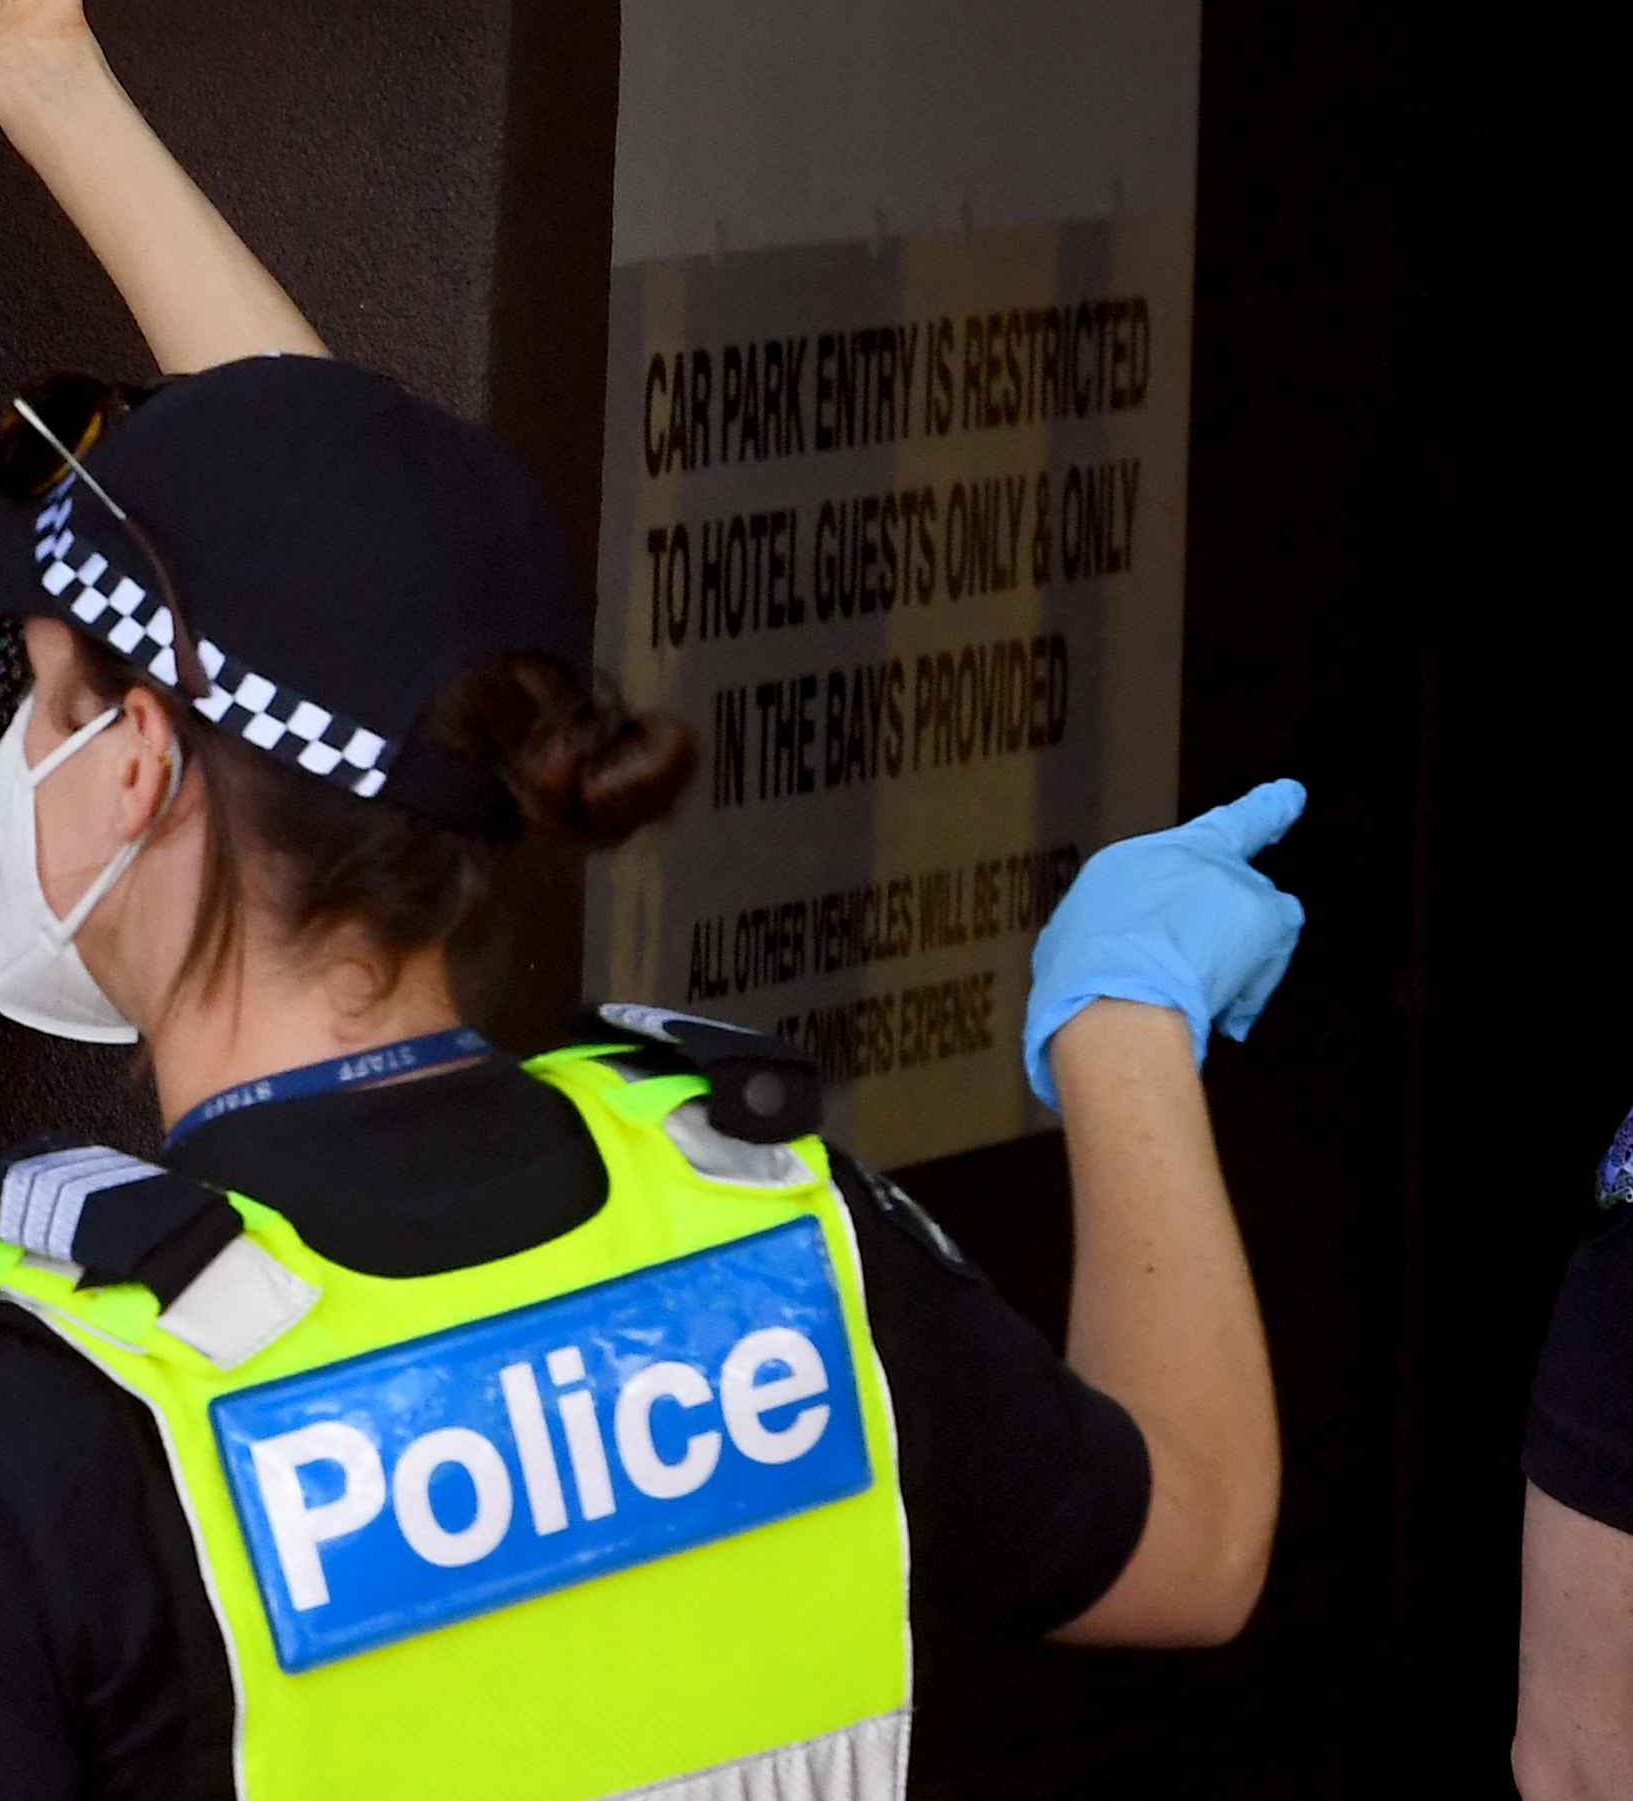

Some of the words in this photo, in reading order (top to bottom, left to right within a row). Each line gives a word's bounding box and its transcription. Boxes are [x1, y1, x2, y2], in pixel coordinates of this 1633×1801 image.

[644, 350, 712, 478] CAR
[721, 336, 807, 465] PARK
[815, 322, 919, 451] ENTRY
[926, 315, 955, 437] IS
[962, 296, 1151, 431] RESTRICTED
[647, 523, 690, 649] TO
[699, 508, 805, 641] HOTEL
[814, 487, 936, 623] GUESTS
[944, 473, 1027, 602] ONLY
[1033, 469, 1052, 588] &
[1061, 458, 1141, 585] ONLY
[714, 687, 746, 808] IN
[755, 675, 817, 800] THE
[824, 656, 905, 787] BAYS
[912, 636, 1069, 770] PROVIDED
[688, 917, 729, 1004] ALL
[735, 902, 806, 993] OTHER
[812, 874, 913, 973] VEHICLES
[919, 867, 967, 952] WILL
[974, 859, 1002, 941] BE
[336, 1045, 418, 1082] STAFF
[250, 1326, 831, 1611] Police
